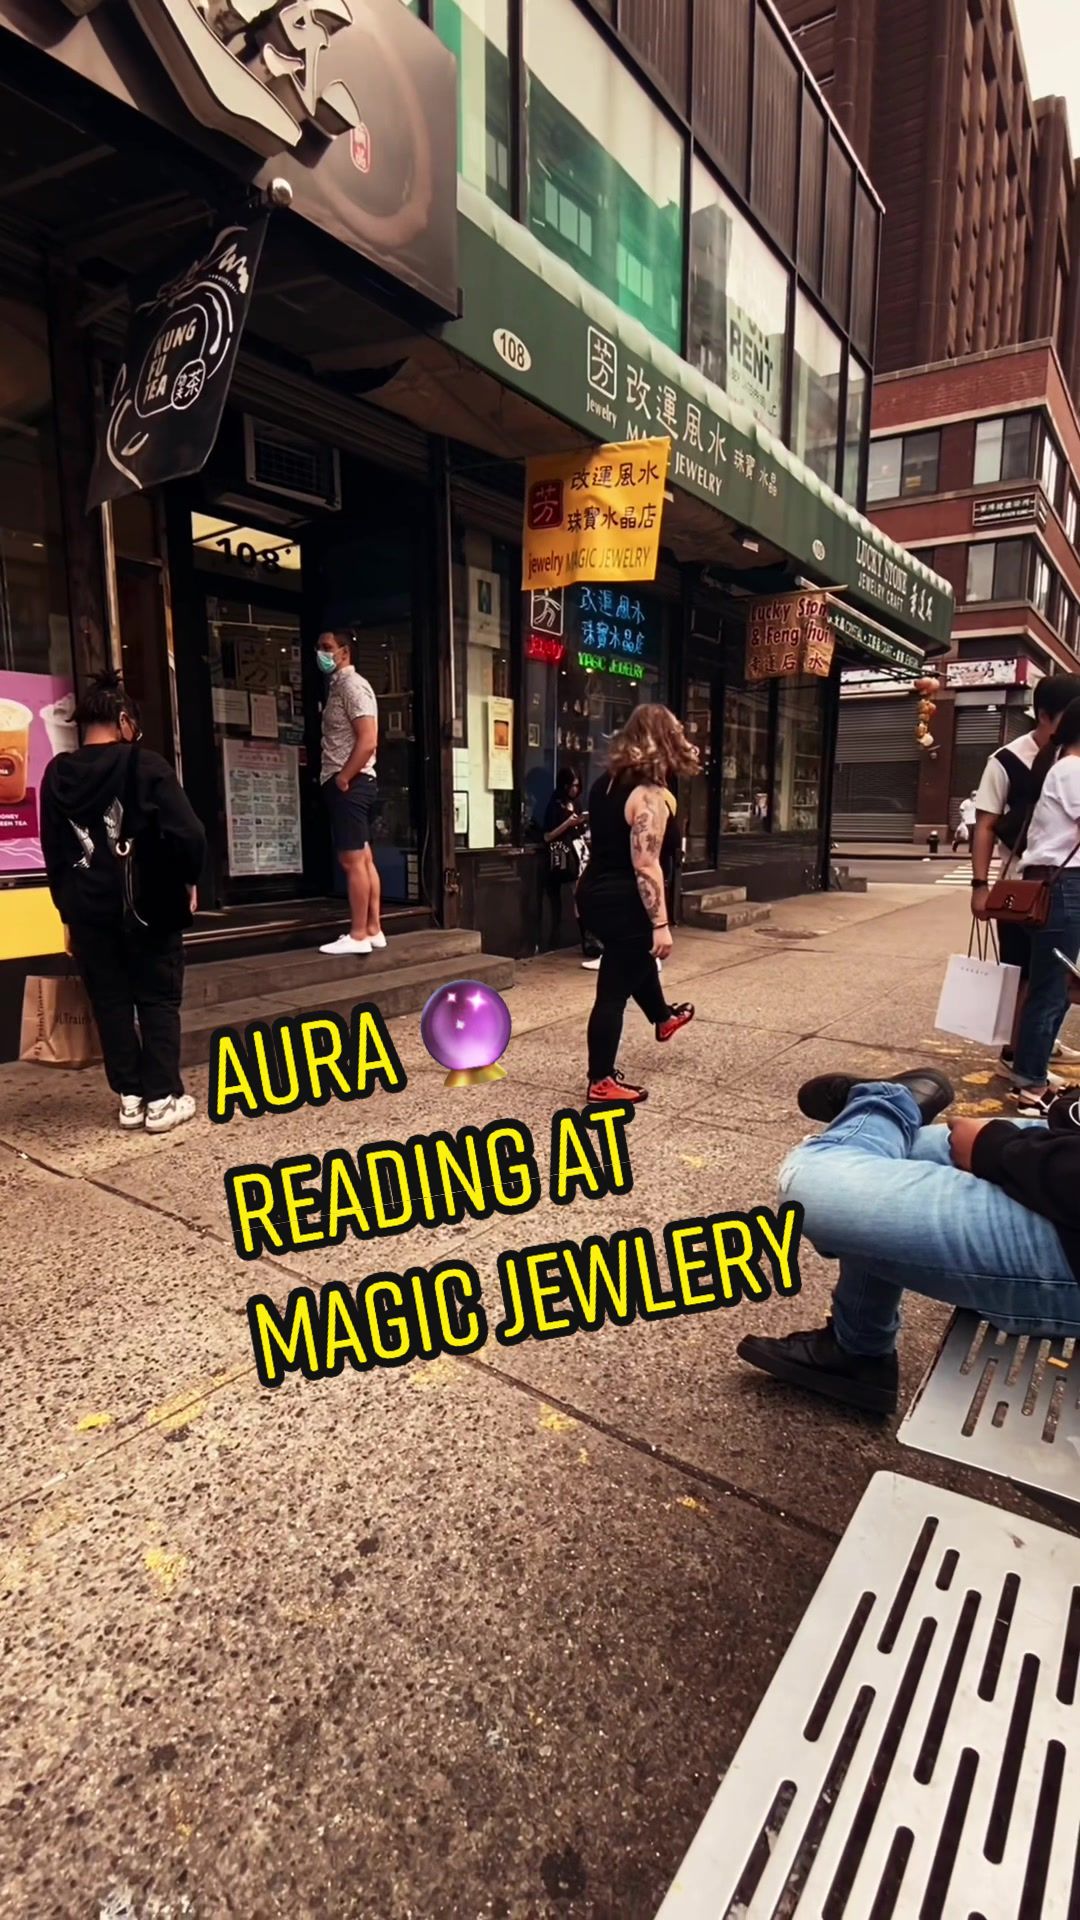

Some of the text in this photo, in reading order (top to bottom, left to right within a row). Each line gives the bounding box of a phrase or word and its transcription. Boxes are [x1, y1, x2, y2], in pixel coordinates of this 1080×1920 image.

[154, 318, 198, 359] KUNG
[501, 332, 525, 369] 108
[730, 318, 773, 392] RENT
[148, 354, 167, 383] FU
[143, 374, 168, 405] TEA
[586, 392, 617, 429] Jewelry
[626, 363, 727, 466] 改運風水
[570, 459, 660, 491] 改運風水
[674, 451, 723, 497] JEWELRY
[567, 503, 657, 533] 珠寶水晶店
[215, 537, 280, 574] 108
[527, 551, 564, 581] jewelry
[599, 547, 651, 569] JEWELRY
[856, 535, 884, 578] LUCKY
[751, 598, 828, 623] Lucky Ston
[766, 626, 800, 647] Feng
[806, 620, 830, 644] hui
